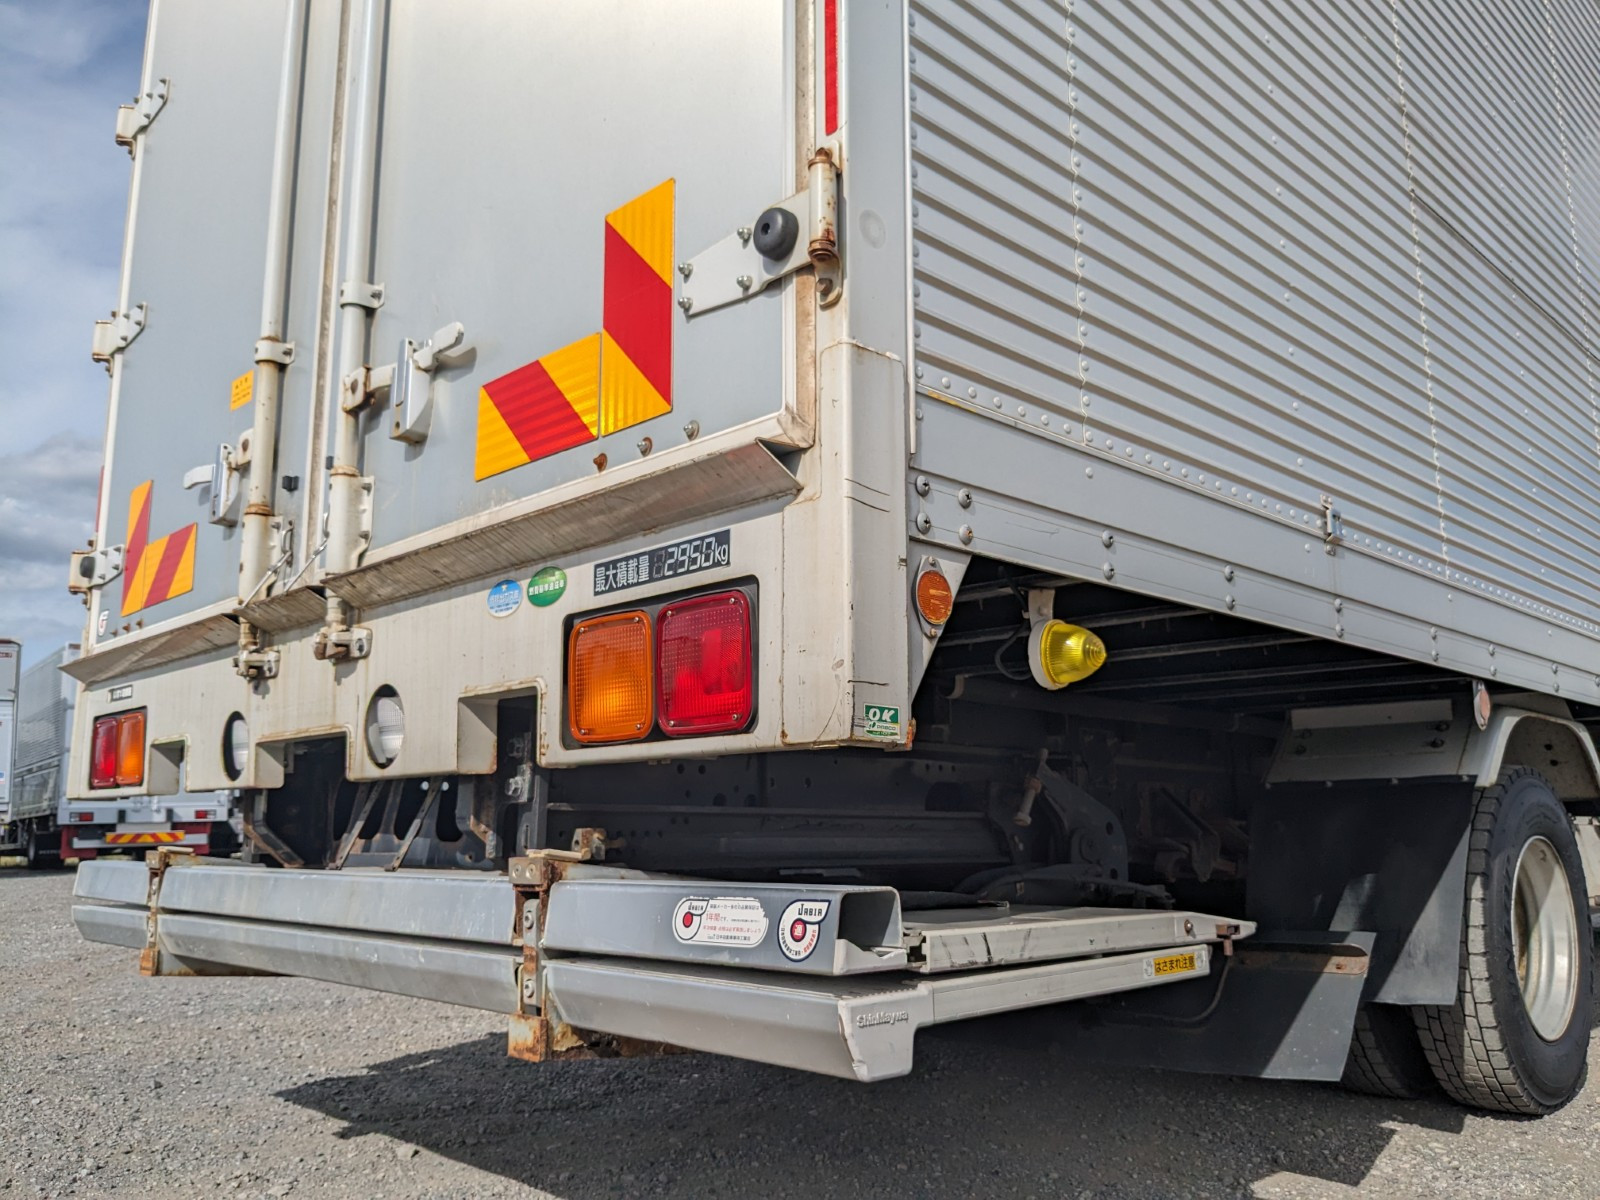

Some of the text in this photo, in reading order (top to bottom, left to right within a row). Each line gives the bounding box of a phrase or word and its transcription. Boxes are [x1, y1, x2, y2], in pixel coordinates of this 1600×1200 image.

[595, 555, 650, 592] 最大積載量
[868, 708, 896, 722] OK
[797, 903, 823, 917] JABIA
[1154, 955, 1195, 973] はさまれ注意
